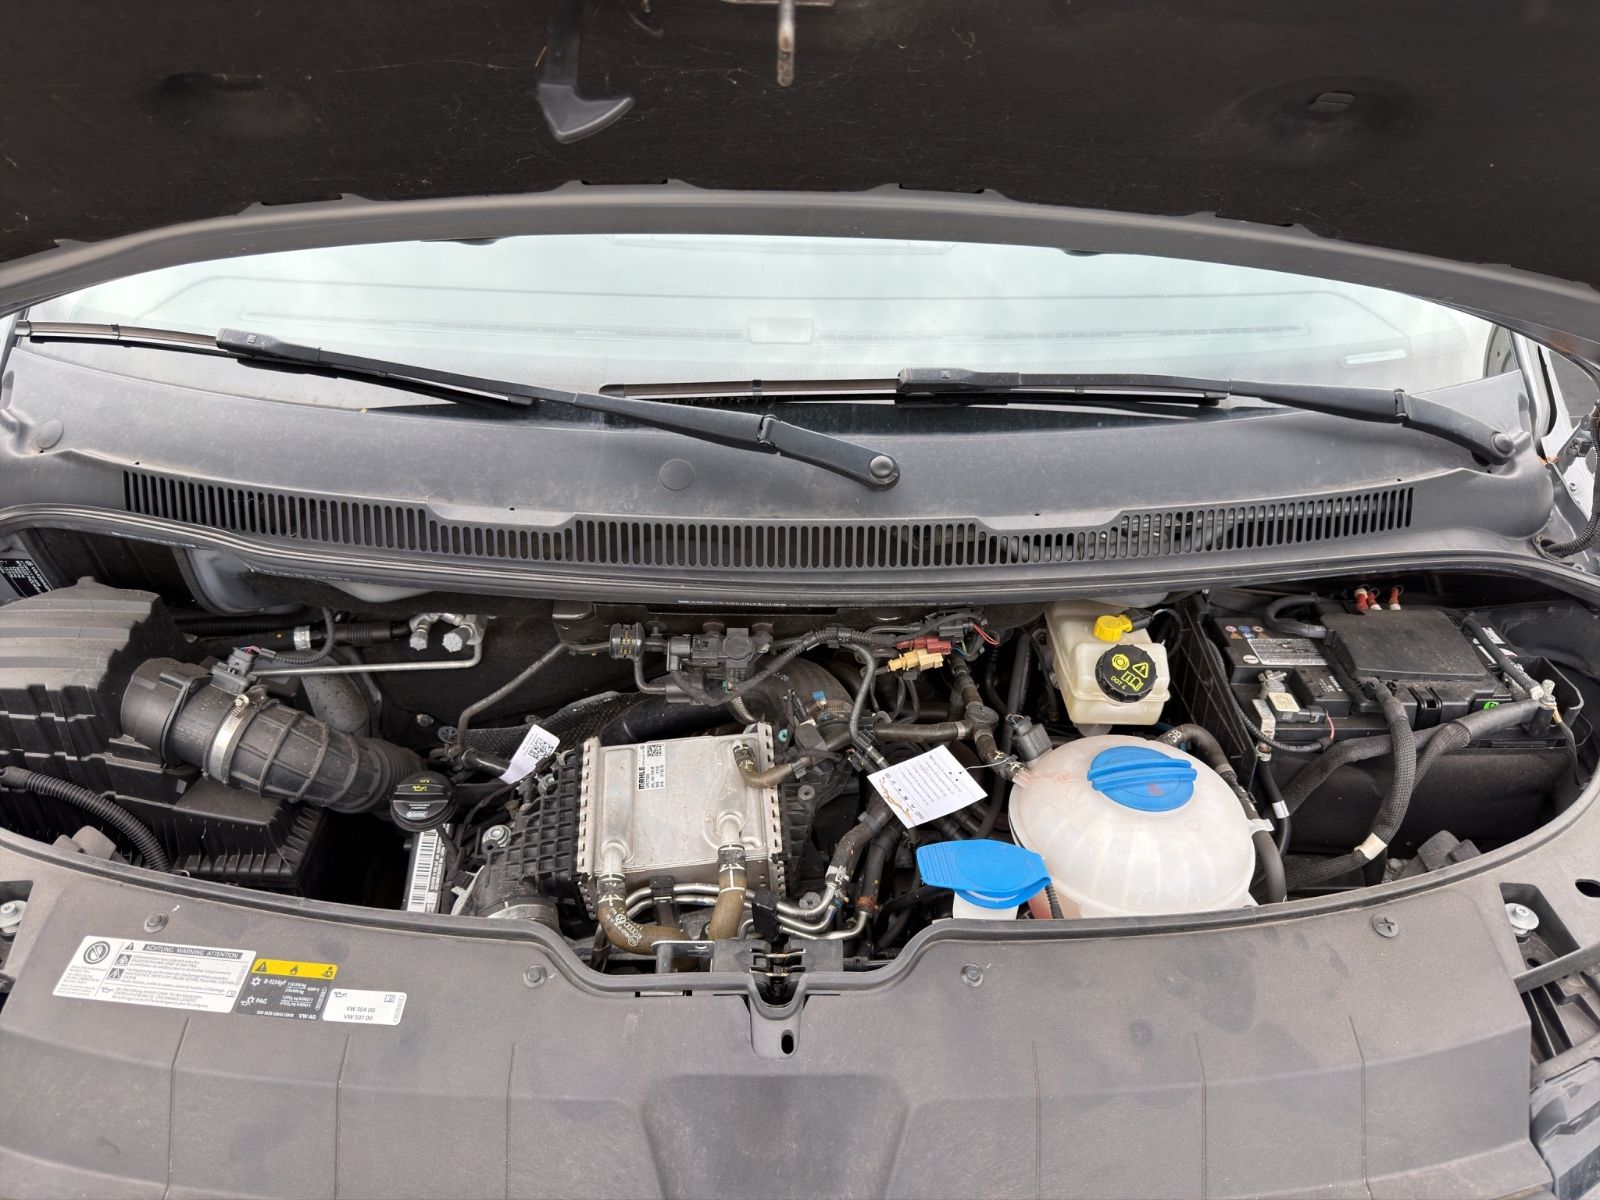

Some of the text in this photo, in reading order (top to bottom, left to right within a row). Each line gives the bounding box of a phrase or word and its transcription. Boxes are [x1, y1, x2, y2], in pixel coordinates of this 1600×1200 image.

[1110, 675, 1123, 686] DOT
[145, 944, 239, 960] ACHTUNG WARNING ATTENTION
